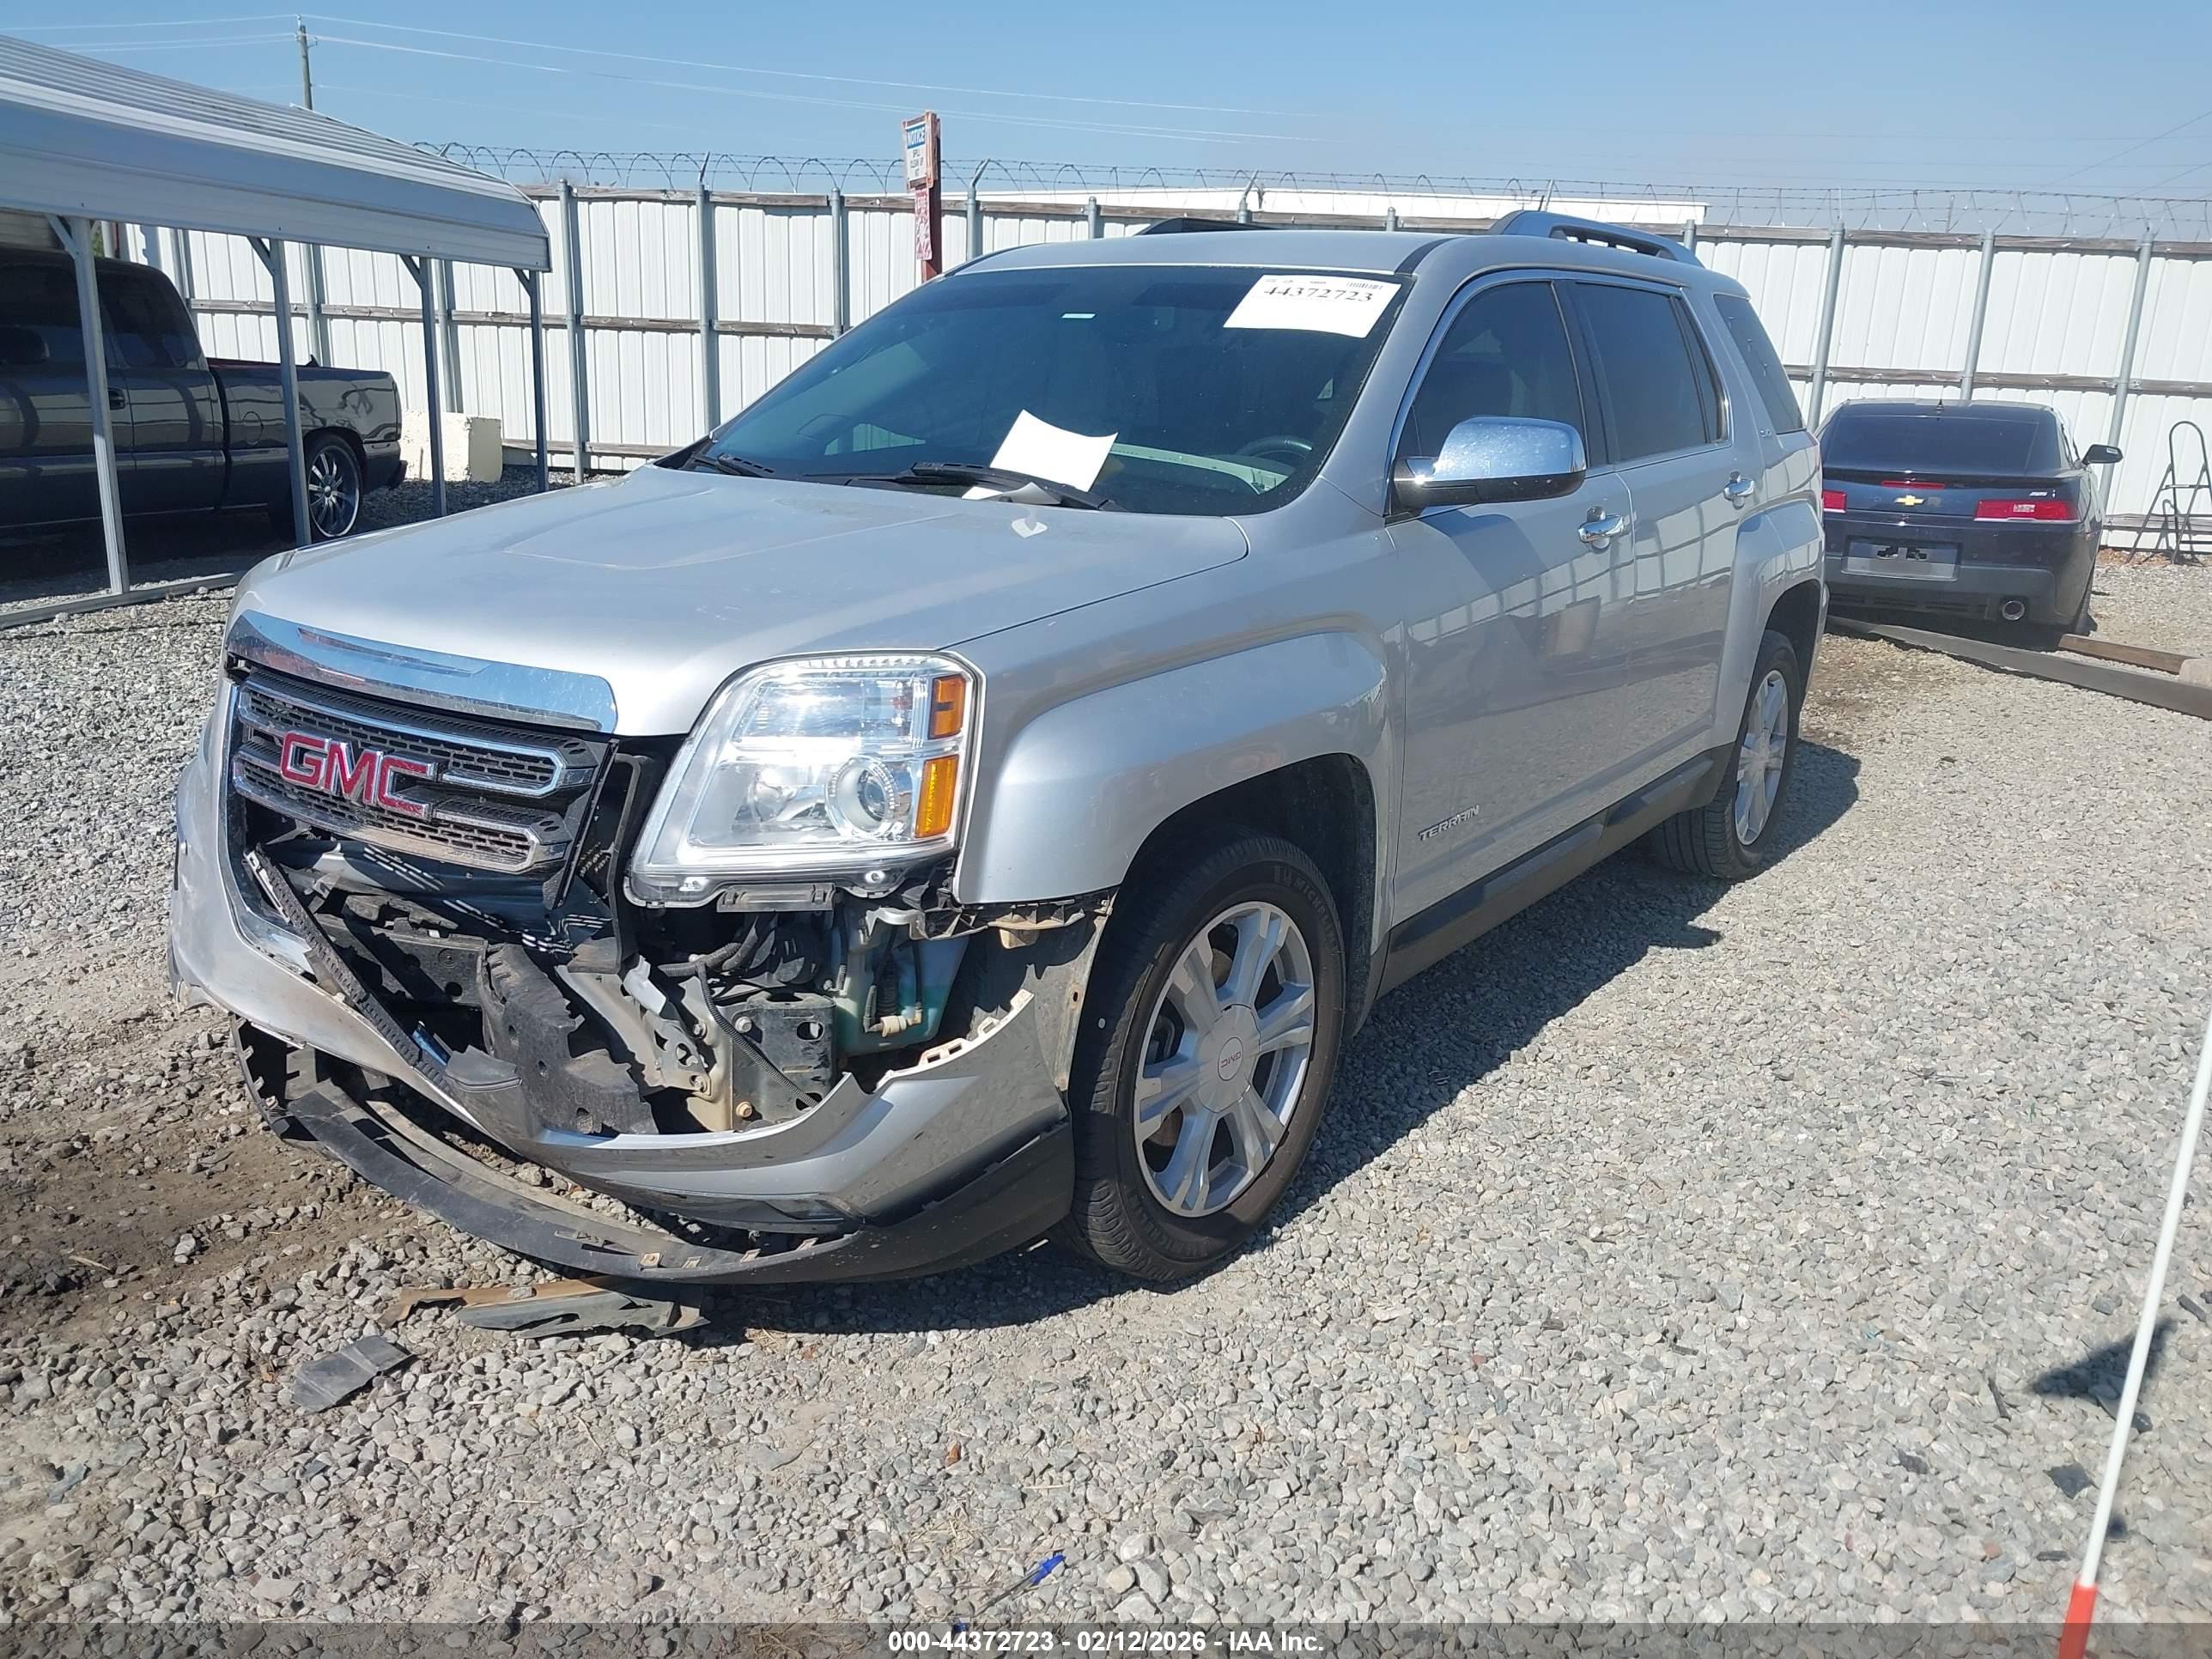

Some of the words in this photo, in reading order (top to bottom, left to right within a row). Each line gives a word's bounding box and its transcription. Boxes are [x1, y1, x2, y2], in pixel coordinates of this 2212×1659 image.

[907, 125, 926, 147] NOTICE
[1264, 286, 1373, 302] 44372723
[281, 731, 436, 820] GMC
[1419, 805, 1480, 841] TERRAIN
[1220, 1050, 1242, 1068] GMC
